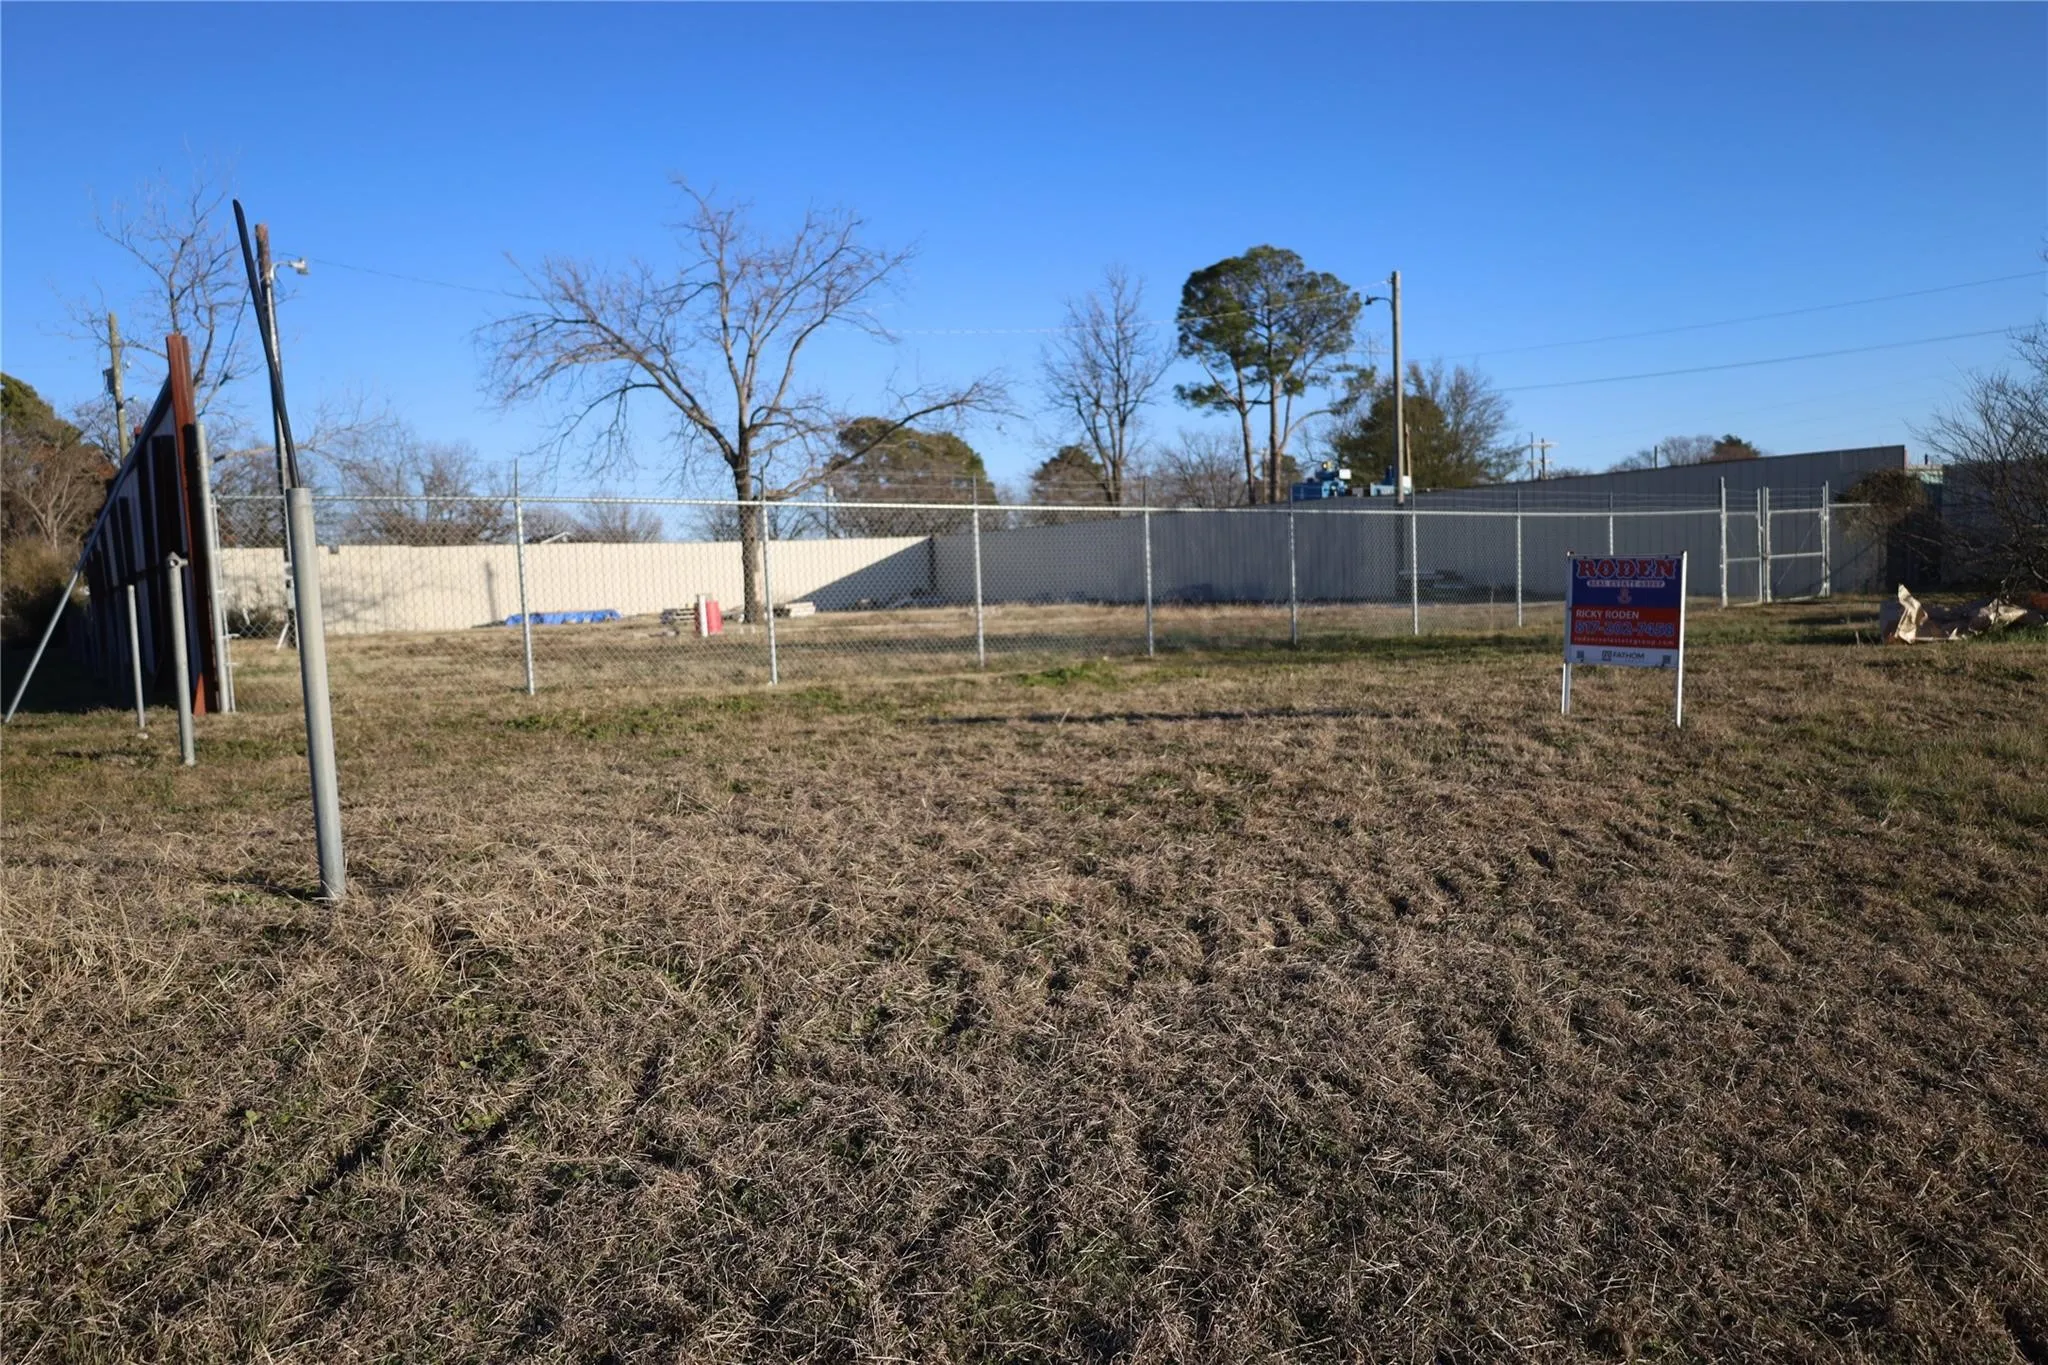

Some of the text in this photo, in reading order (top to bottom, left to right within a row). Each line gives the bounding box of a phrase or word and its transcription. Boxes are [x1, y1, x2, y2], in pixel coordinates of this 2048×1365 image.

[1577, 559, 1676, 578] RODEN
[1576, 609, 1639, 619] RICKY RODEN
[1613, 651, 1645, 659] FATHOM
